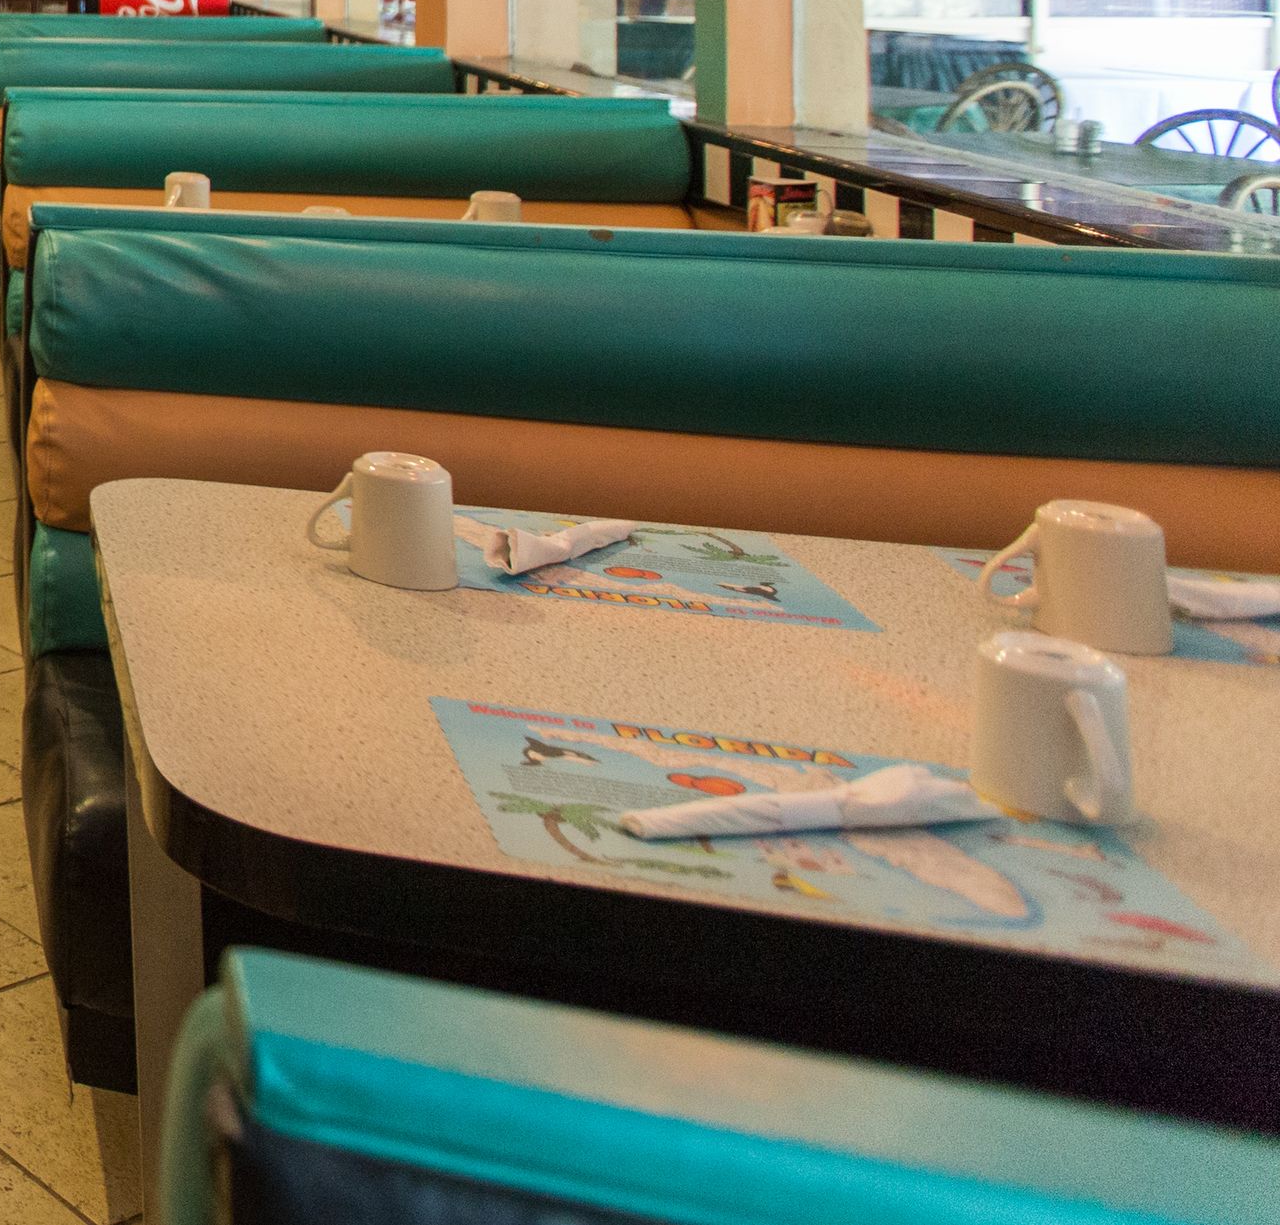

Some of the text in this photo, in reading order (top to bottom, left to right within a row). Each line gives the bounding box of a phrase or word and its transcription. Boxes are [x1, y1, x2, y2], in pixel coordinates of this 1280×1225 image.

[518, 581, 713, 612] FLORIDA
[467, 702, 857, 769] Welcome to FLORIDA
